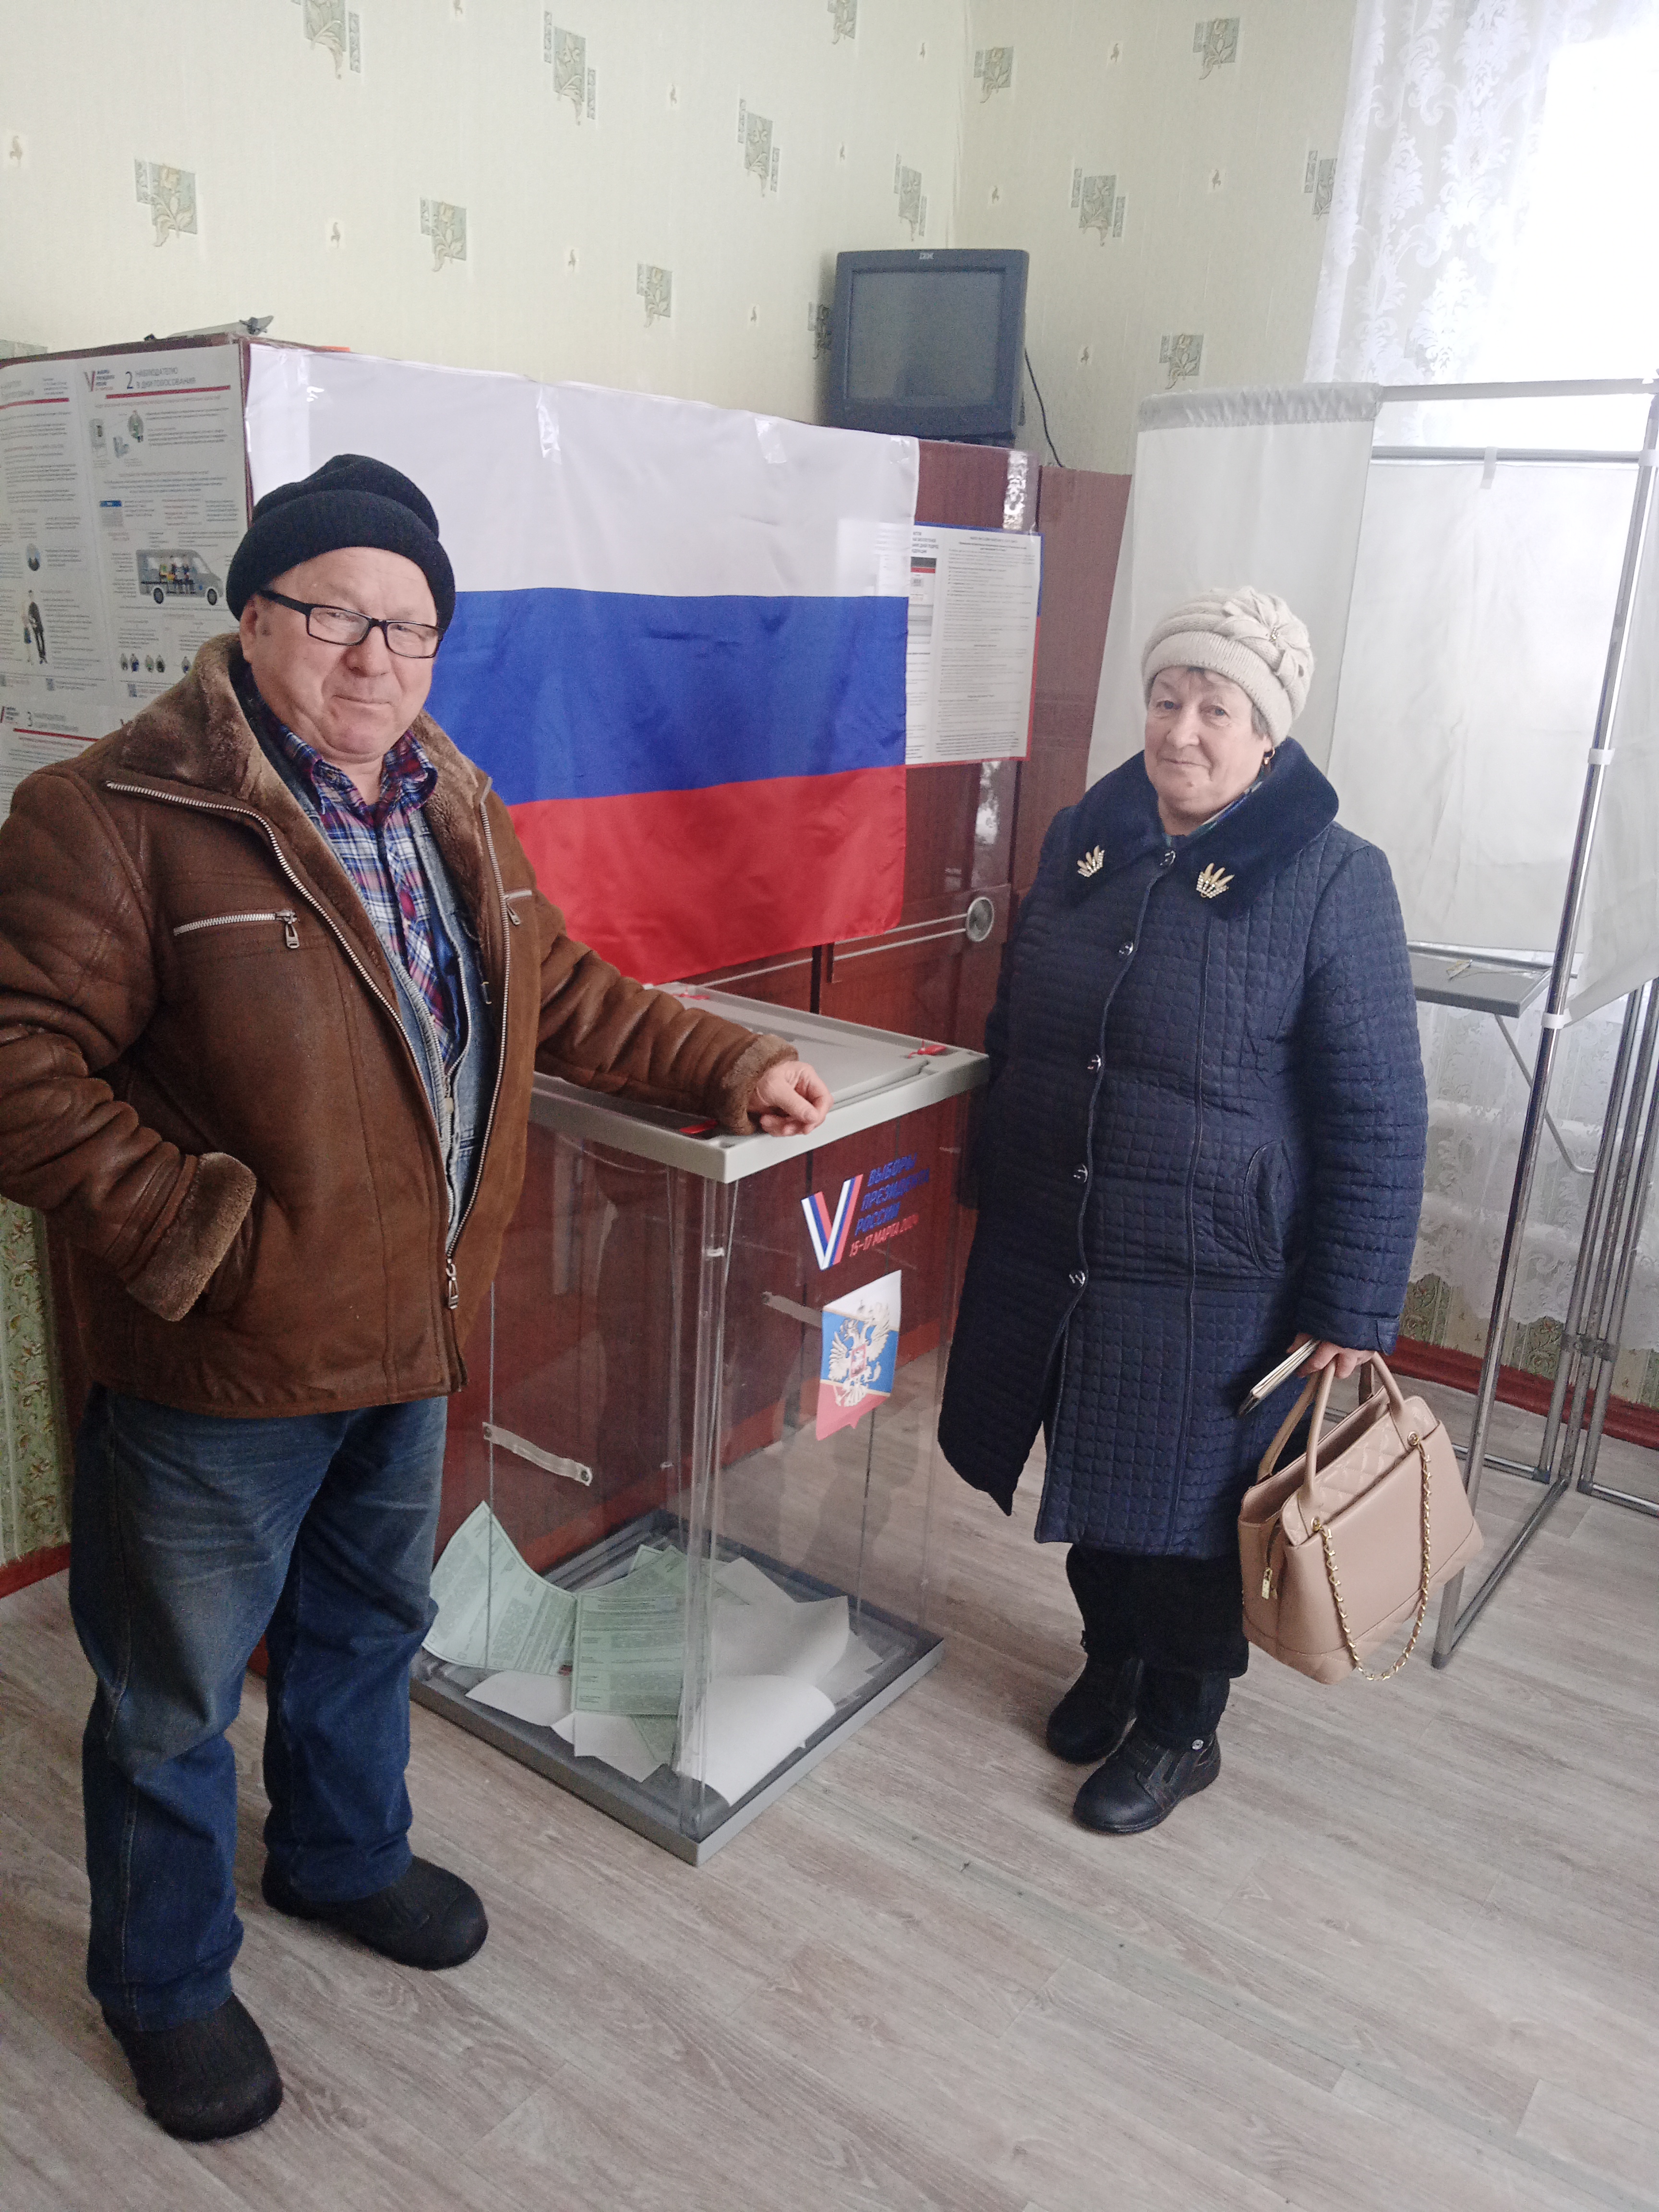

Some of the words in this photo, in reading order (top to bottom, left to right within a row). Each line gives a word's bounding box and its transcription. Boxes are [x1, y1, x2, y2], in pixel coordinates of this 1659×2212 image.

[125, 371, 133, 389] 2
[867, 1152, 917, 1187] ВЫБОРЫ
[861, 1168, 929, 1211] ПРЕЗИДЕНТА
[854, 1201, 901, 1237] РОССИИ
